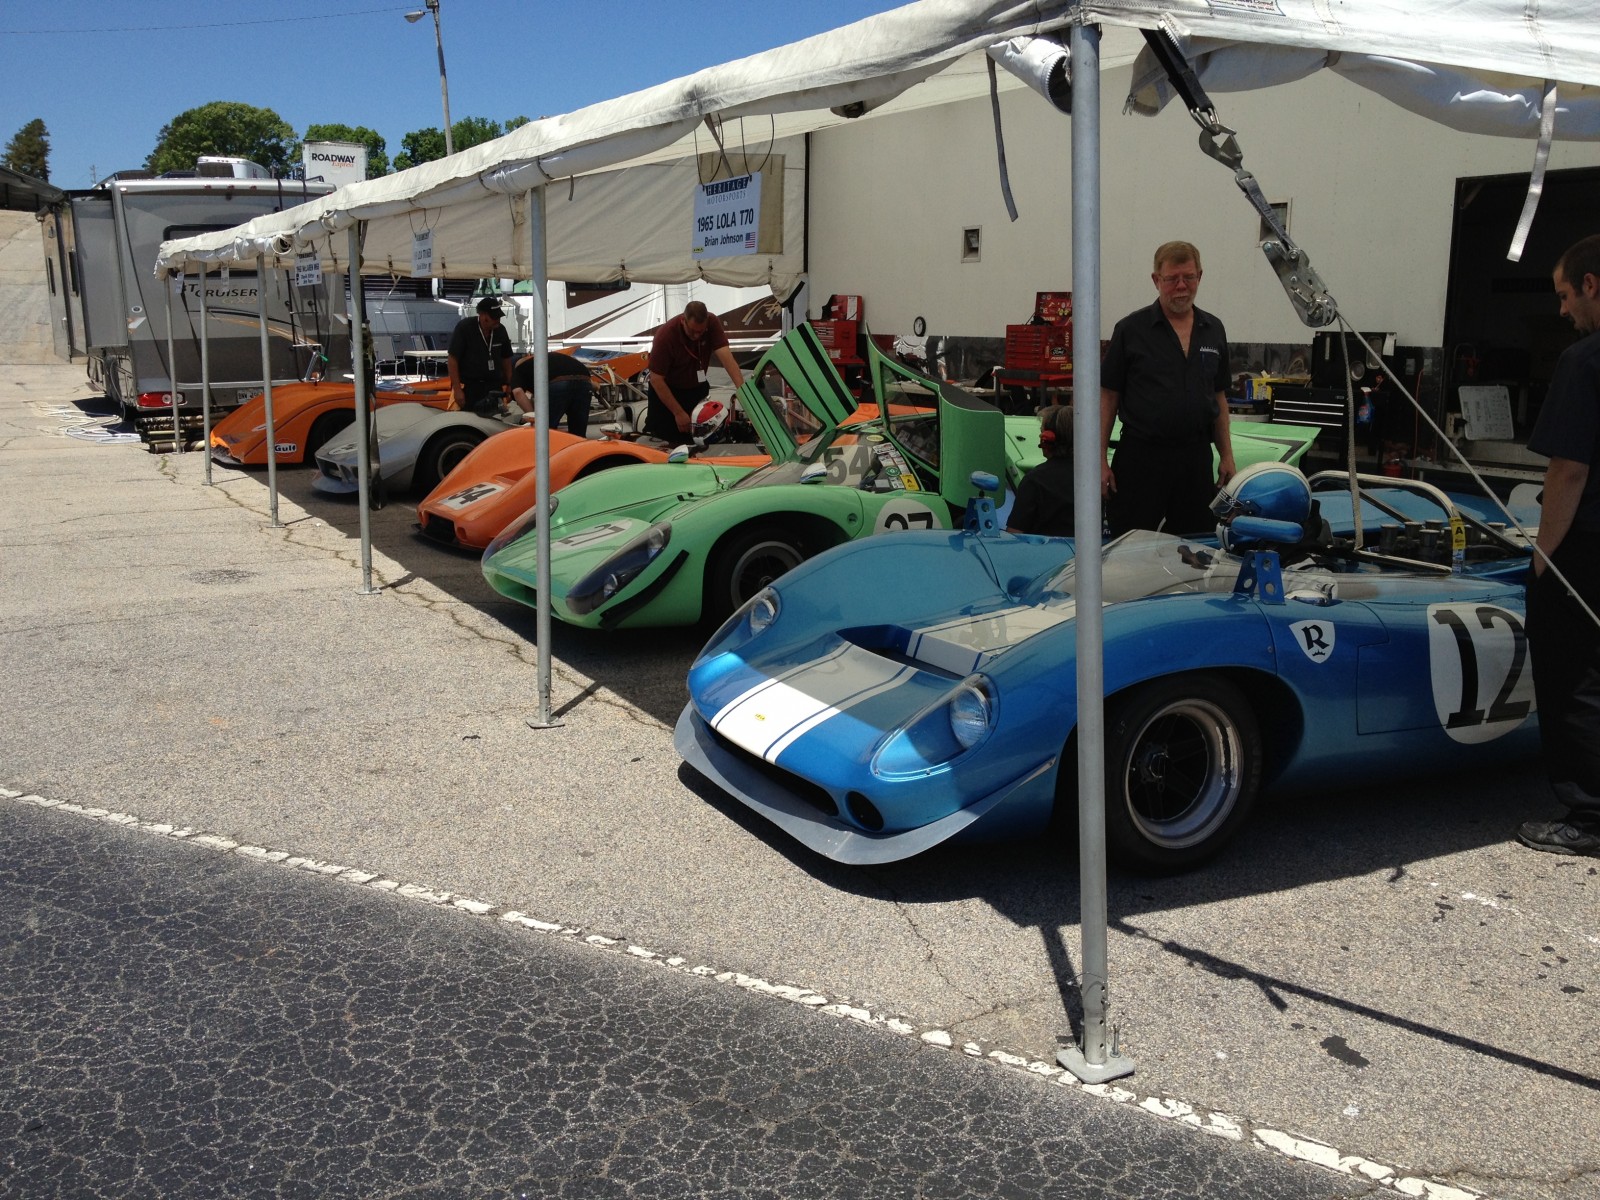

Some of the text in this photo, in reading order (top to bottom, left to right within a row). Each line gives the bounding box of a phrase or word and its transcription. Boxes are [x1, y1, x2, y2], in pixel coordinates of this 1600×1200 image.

[312, 153, 355, 163] ROADWAY
[332, 160, 354, 168] Express
[707, 178, 748, 195] HERITAGE
[707, 190, 746, 205] MOTORSPORTS
[698, 207, 754, 232] 1965 LOLA T70
[704, 233, 744, 247] Brian Johnson
[275, 444, 296, 452] Gulf
[1301, 624, 1330, 650] R
[1432, 606, 1531, 730] 12
